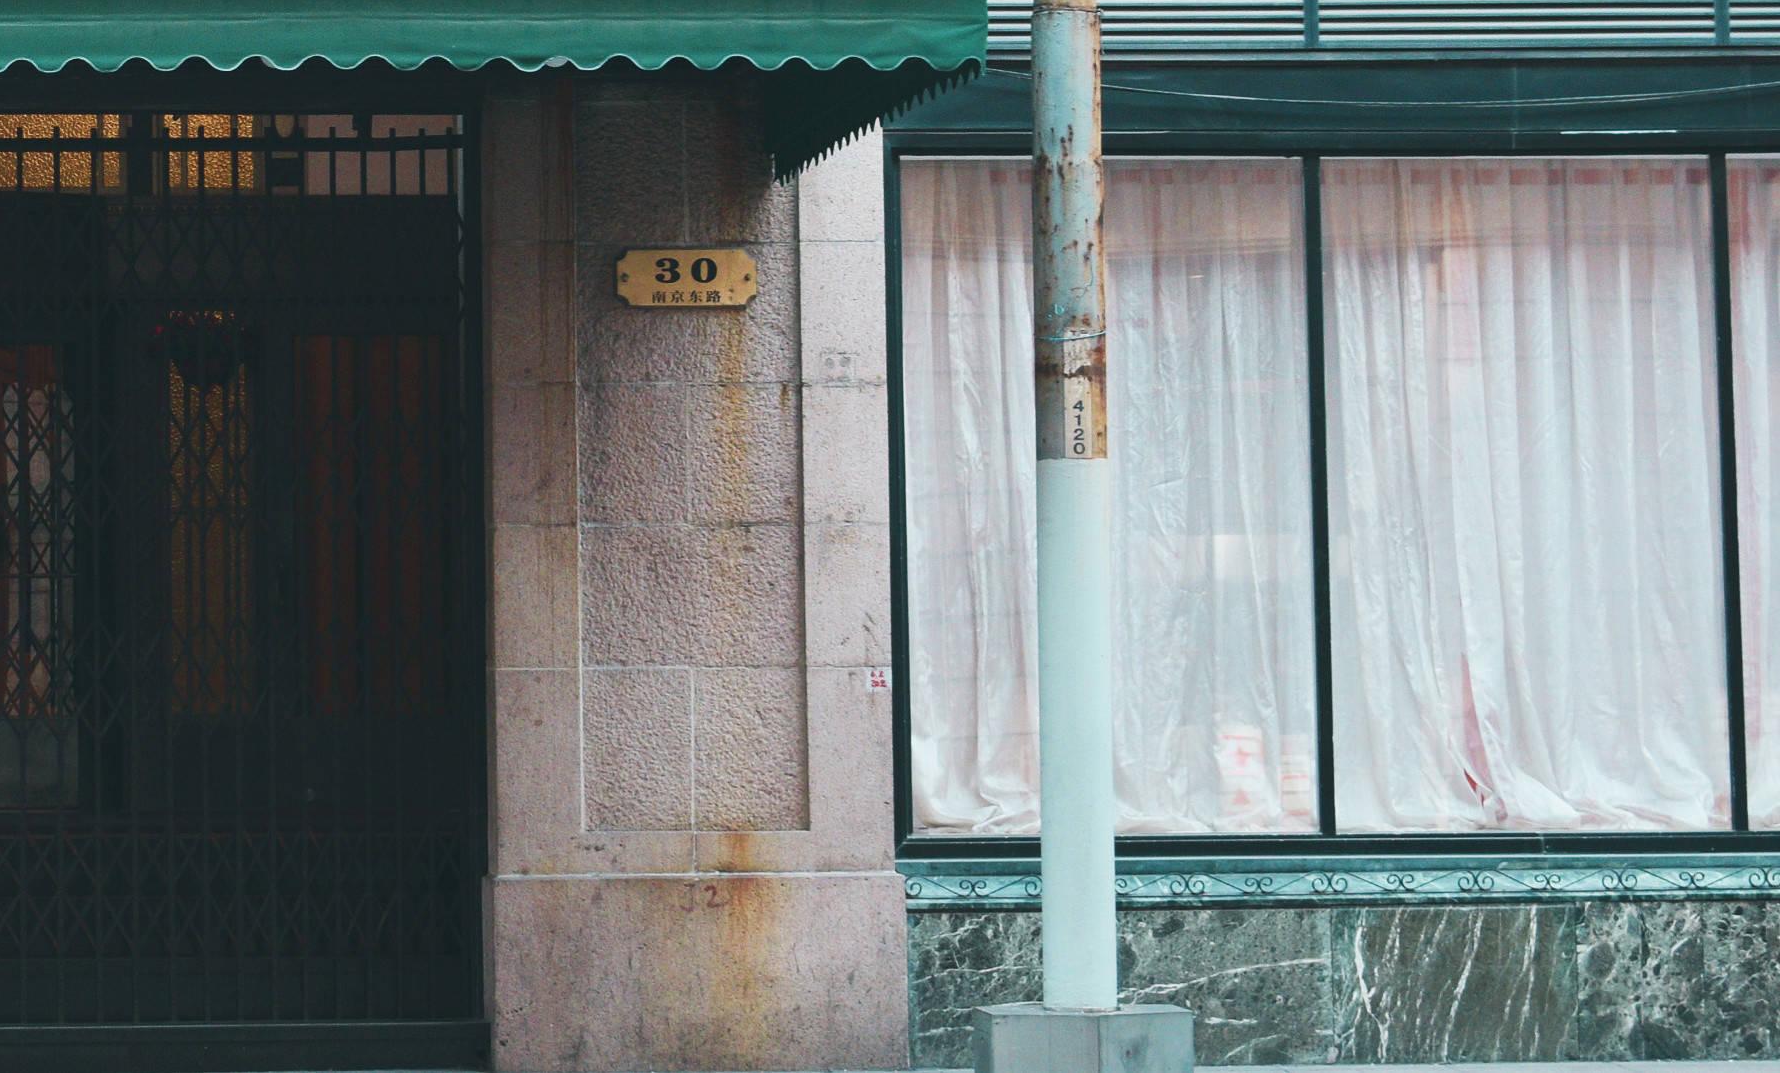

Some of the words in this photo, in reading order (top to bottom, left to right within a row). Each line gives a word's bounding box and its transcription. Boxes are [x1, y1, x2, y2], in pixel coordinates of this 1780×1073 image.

[654, 257, 718, 284] 30
[651, 290, 722, 304] 南京东路
[1072, 400, 1086, 455] 4120
